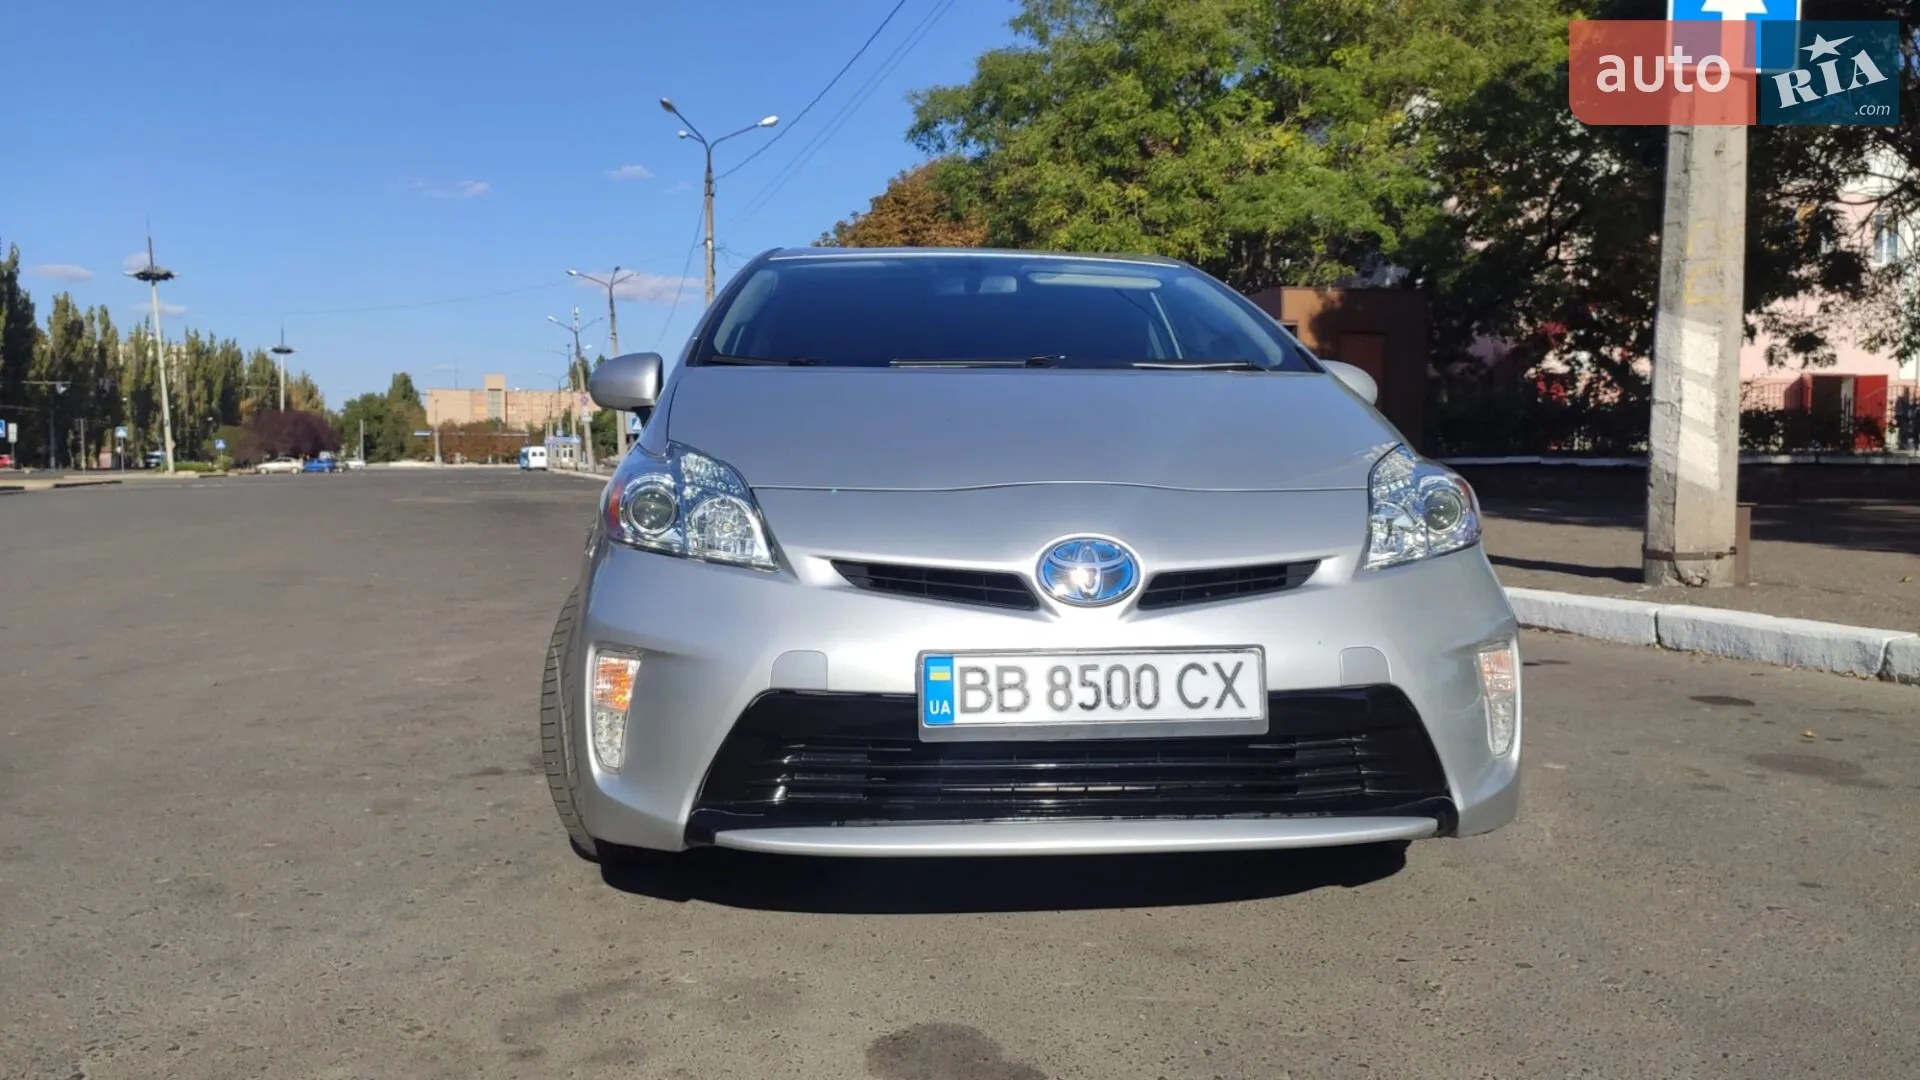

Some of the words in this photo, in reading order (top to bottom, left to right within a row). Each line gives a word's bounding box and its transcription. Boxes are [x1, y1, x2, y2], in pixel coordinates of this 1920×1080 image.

[959, 666, 1030, 713] BB
[1047, 664, 1160, 711] 8500
[1177, 661, 1247, 709] CX
[929, 700, 951, 715] UA
